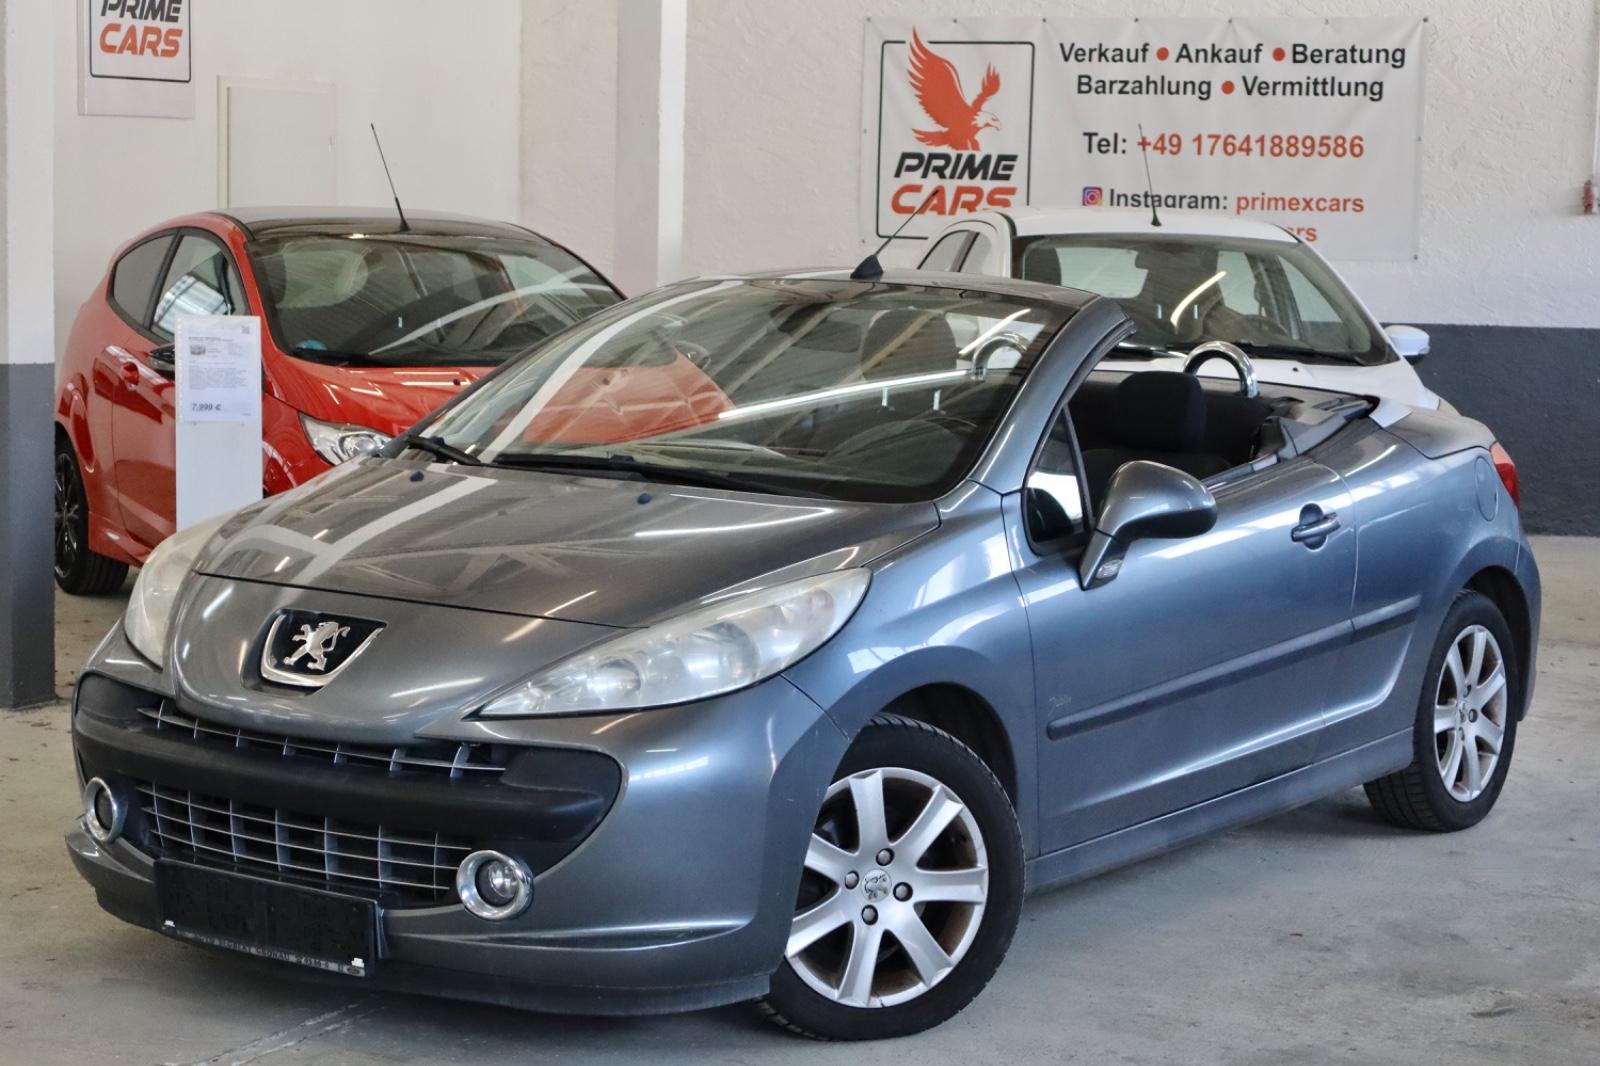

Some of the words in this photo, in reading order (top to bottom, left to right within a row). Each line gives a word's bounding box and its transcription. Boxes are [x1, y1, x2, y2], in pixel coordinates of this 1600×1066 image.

[101, 0, 182, 23] PRIME
[99, 23, 183, 58] CARS
[1059, 42, 1150, 63] Verkauf
[1175, 43, 1263, 64] Ankauf
[1292, 43, 1406, 69] Beratung
[1077, 74, 1212, 101] Barzahlung
[1242, 75, 1384, 102] Vermittlung
[1083, 132, 1127, 154] Tel:
[1137, 133, 1182, 156] +49
[1192, 133, 1364, 158] 17641889586
[893, 152, 1018, 181] PRIME
[891, 184, 1018, 216] CARS
[1109, 188, 1228, 210] Instagram:
[1236, 192, 1365, 215] primexcars
